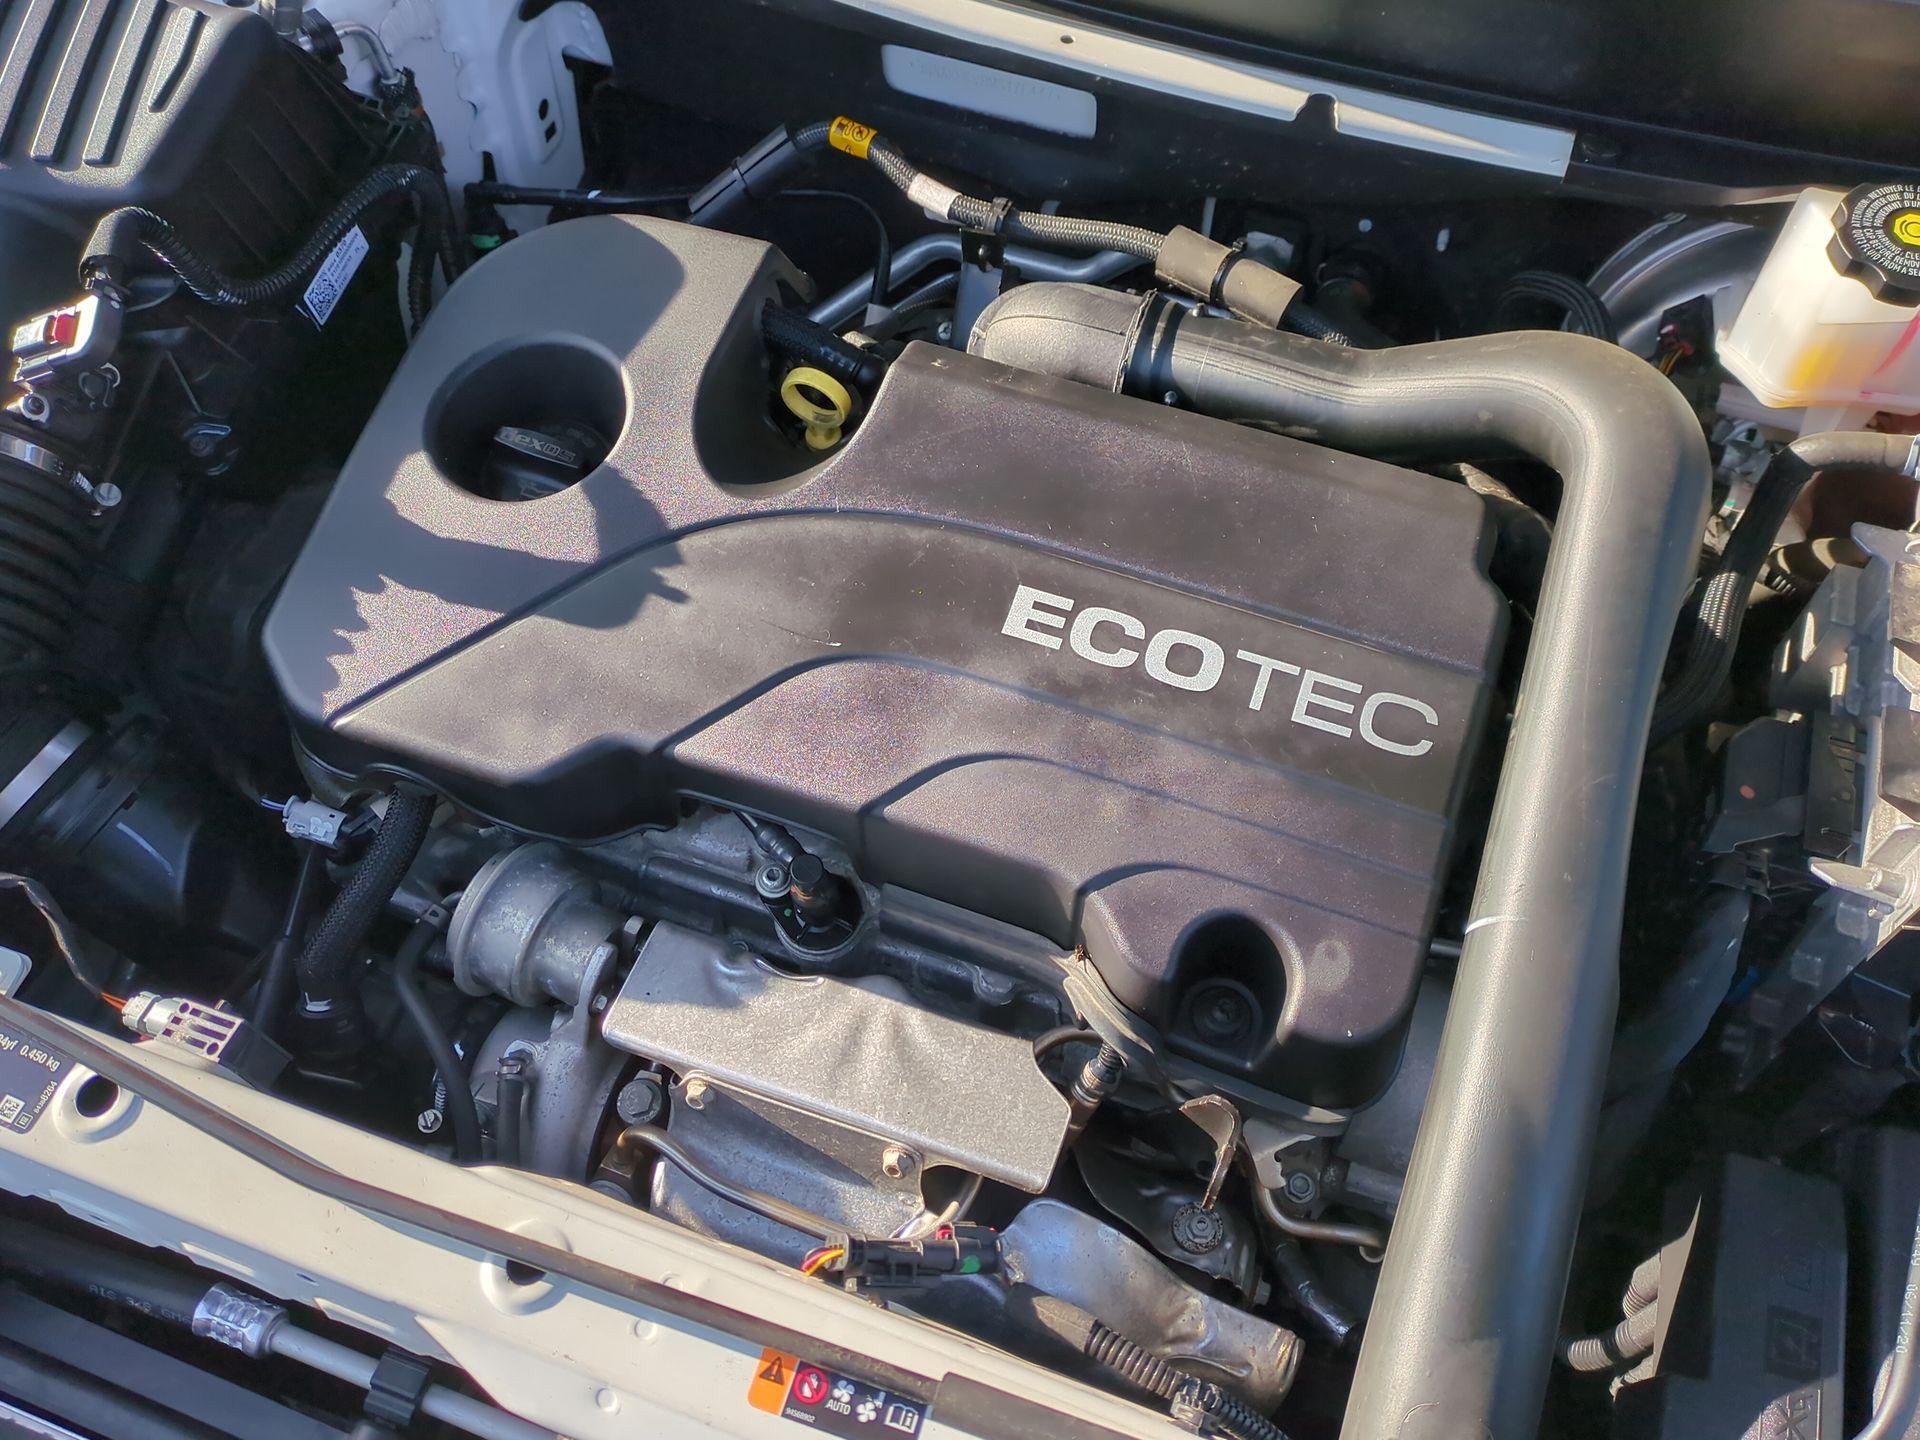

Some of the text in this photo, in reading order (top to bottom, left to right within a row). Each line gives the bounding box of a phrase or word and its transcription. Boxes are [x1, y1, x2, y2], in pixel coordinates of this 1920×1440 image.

[1868, 184, 1904, 200] NETTOYER
[1905, 184, 1914, 192] LE
[1904, 192, 1914, 200] DU
[1860, 243, 1881, 260] FLUID
[1877, 257, 1901, 273] FROM
[1869, 239, 1895, 260] BEFORE
[1001, 584, 1439, 757] ECOTEC
[20, 1044, 47, 1064] 0.450
[46, 1055, 60, 1072] kg
[825, 1399, 851, 1416] AUTO
